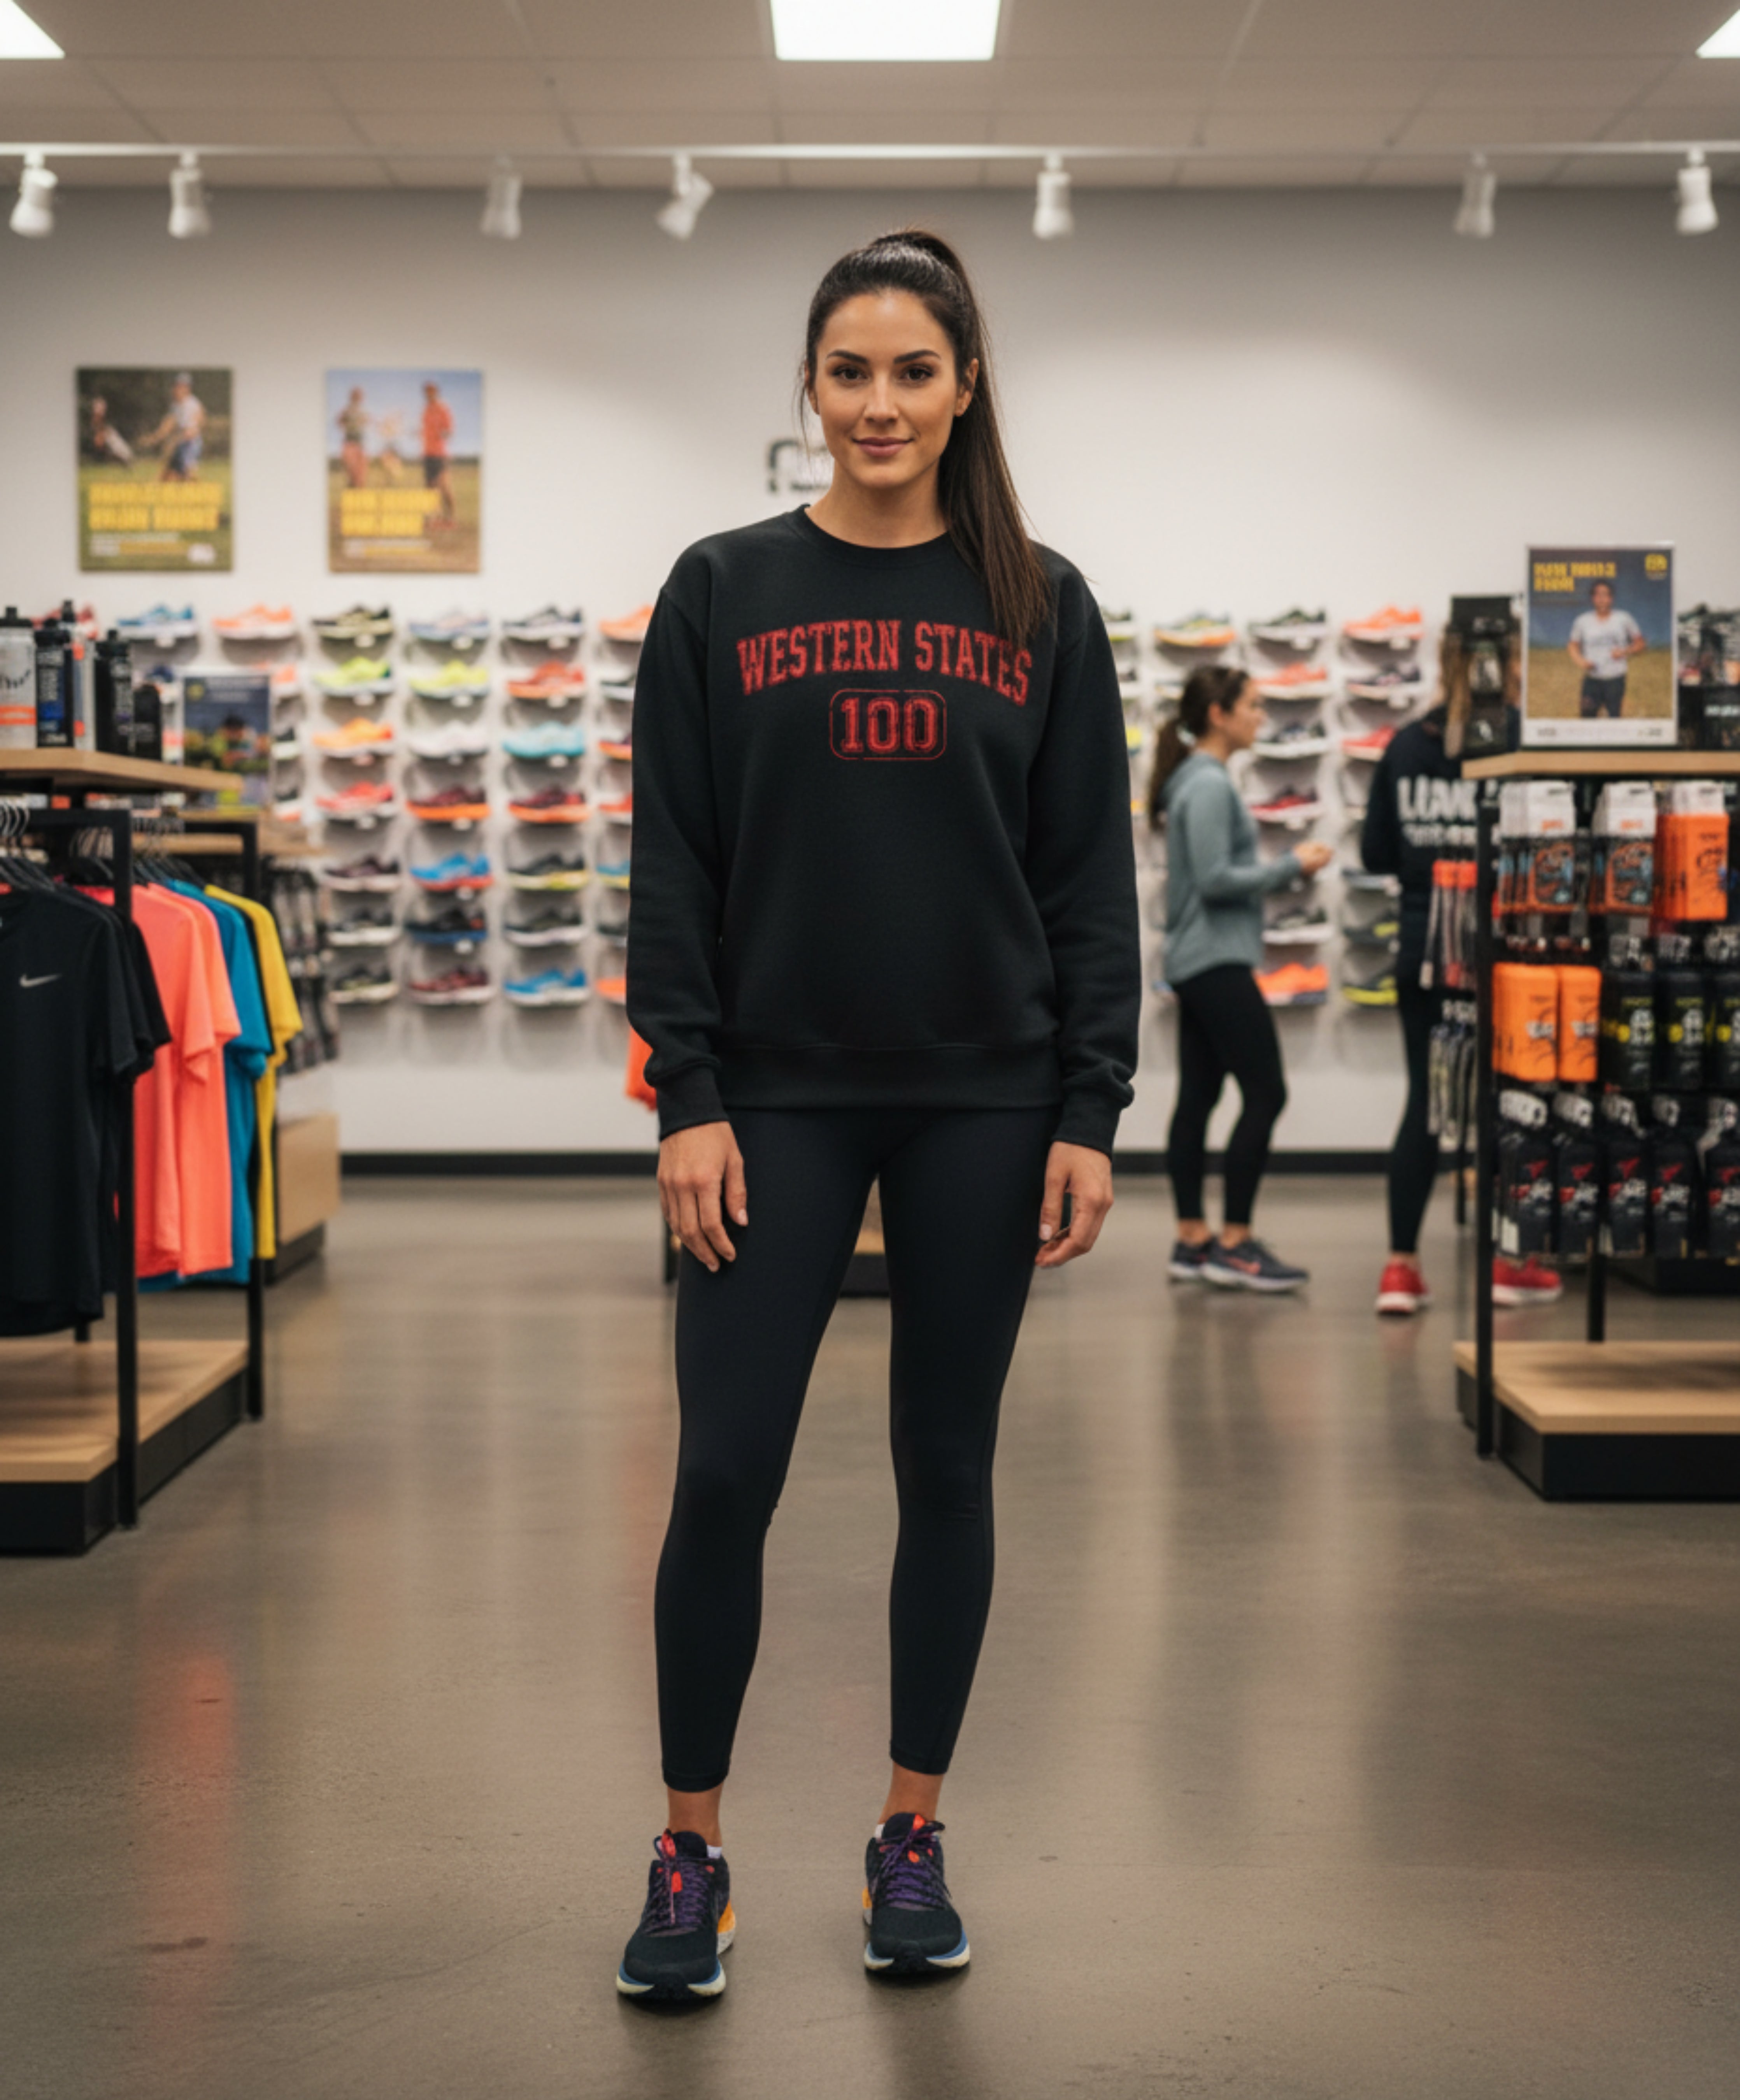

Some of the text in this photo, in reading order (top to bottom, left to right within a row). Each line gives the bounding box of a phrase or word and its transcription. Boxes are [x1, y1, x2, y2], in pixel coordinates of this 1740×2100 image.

[737, 620, 1032, 706] WESTERN STATES
[840, 697, 938, 754] 100
